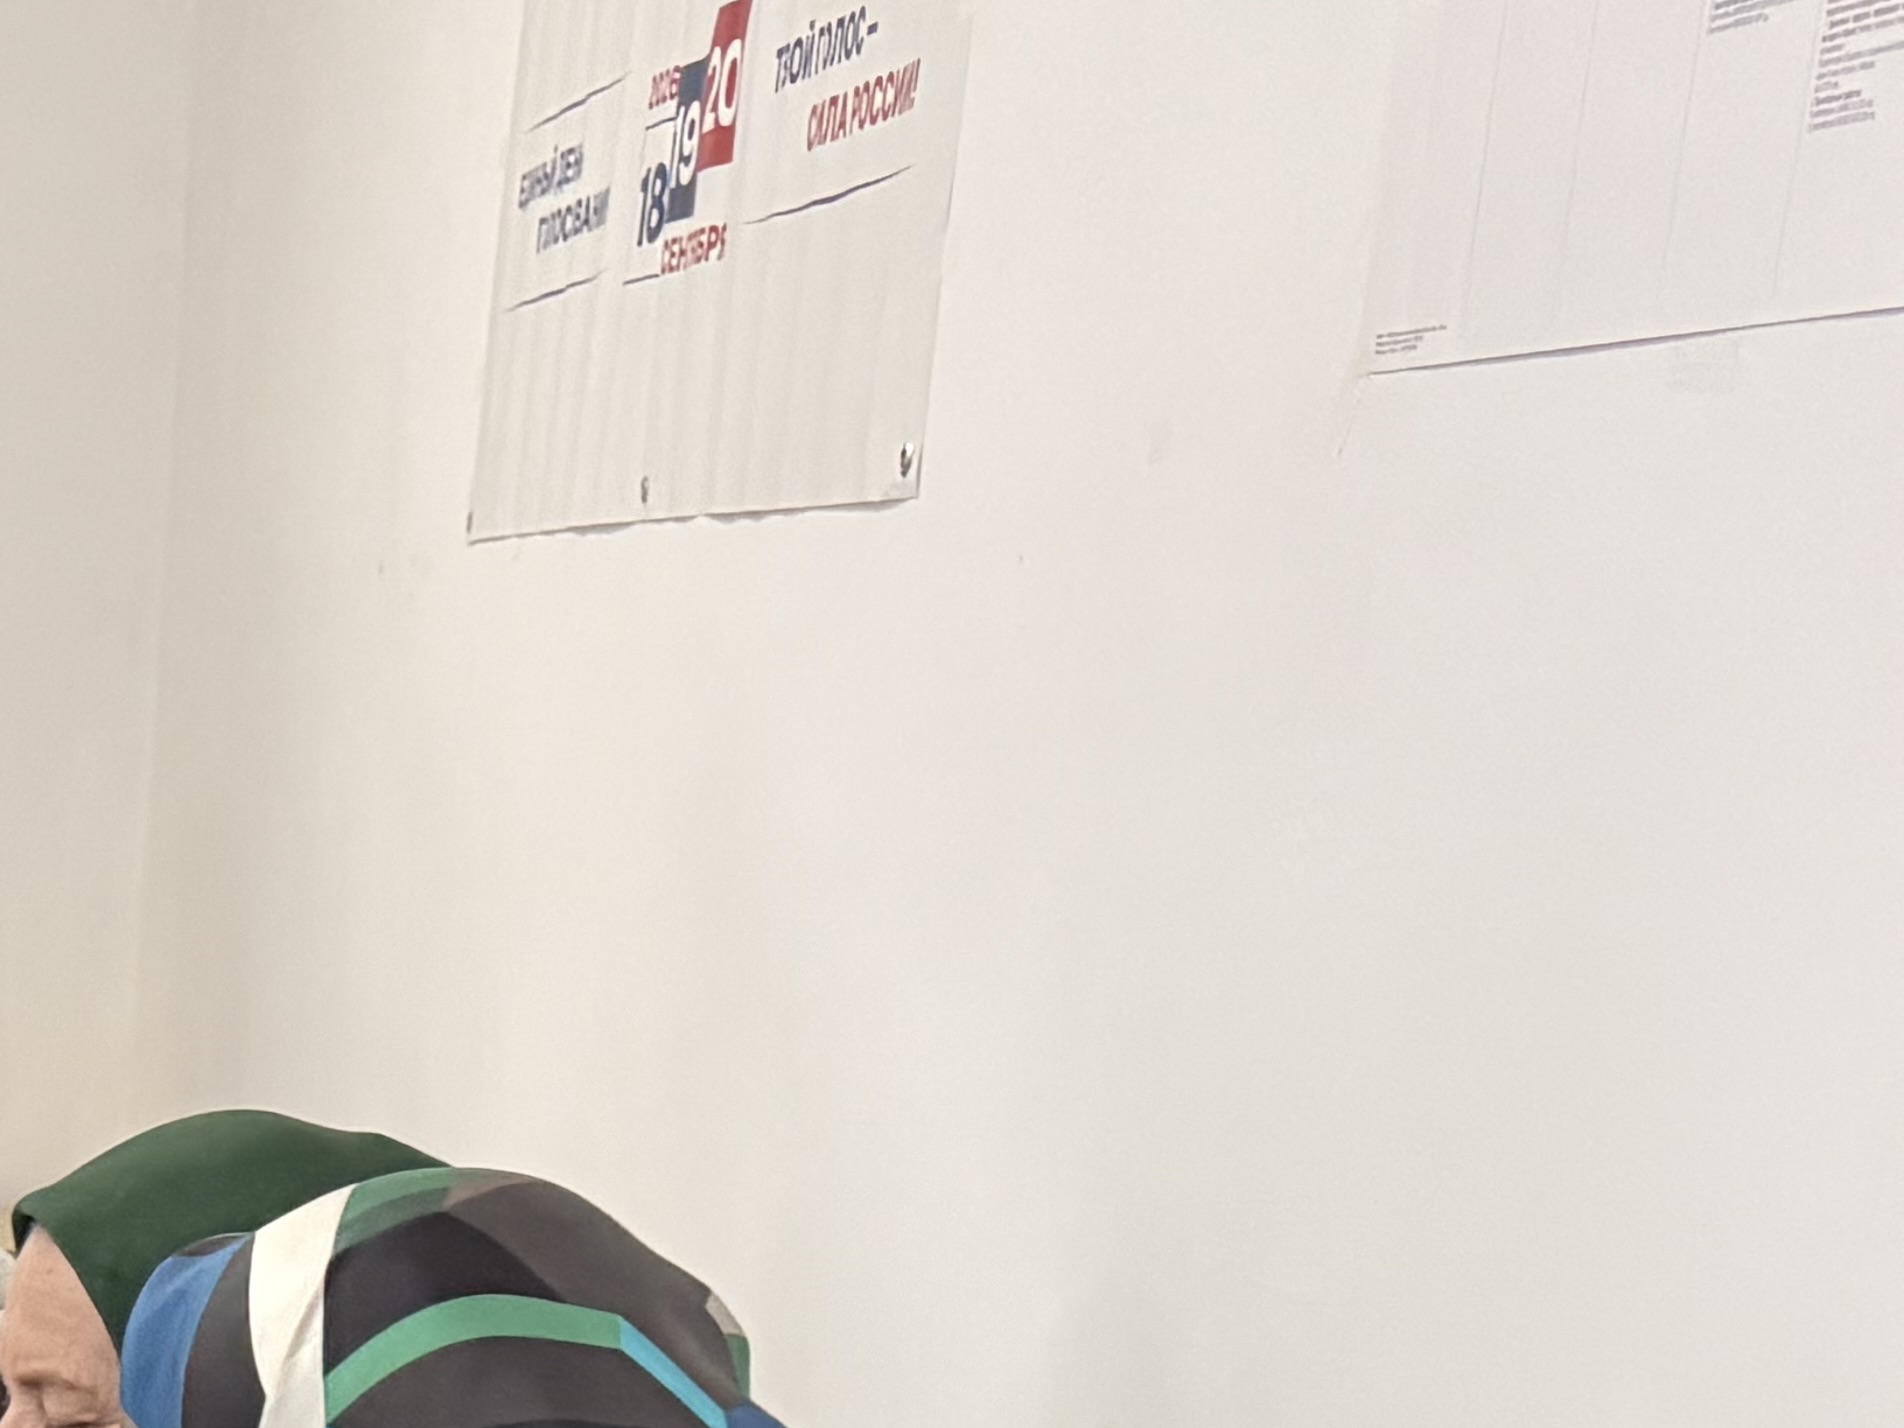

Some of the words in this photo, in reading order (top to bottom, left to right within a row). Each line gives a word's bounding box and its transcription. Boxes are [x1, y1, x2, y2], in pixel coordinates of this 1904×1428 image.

[816, 6, 866, 75] ГОЛОС
[702, 39, 742, 134] 20
[807, 92, 848, 152] СИЛА
[669, 100, 701, 189] 19
[637, 162, 668, 247] 18
